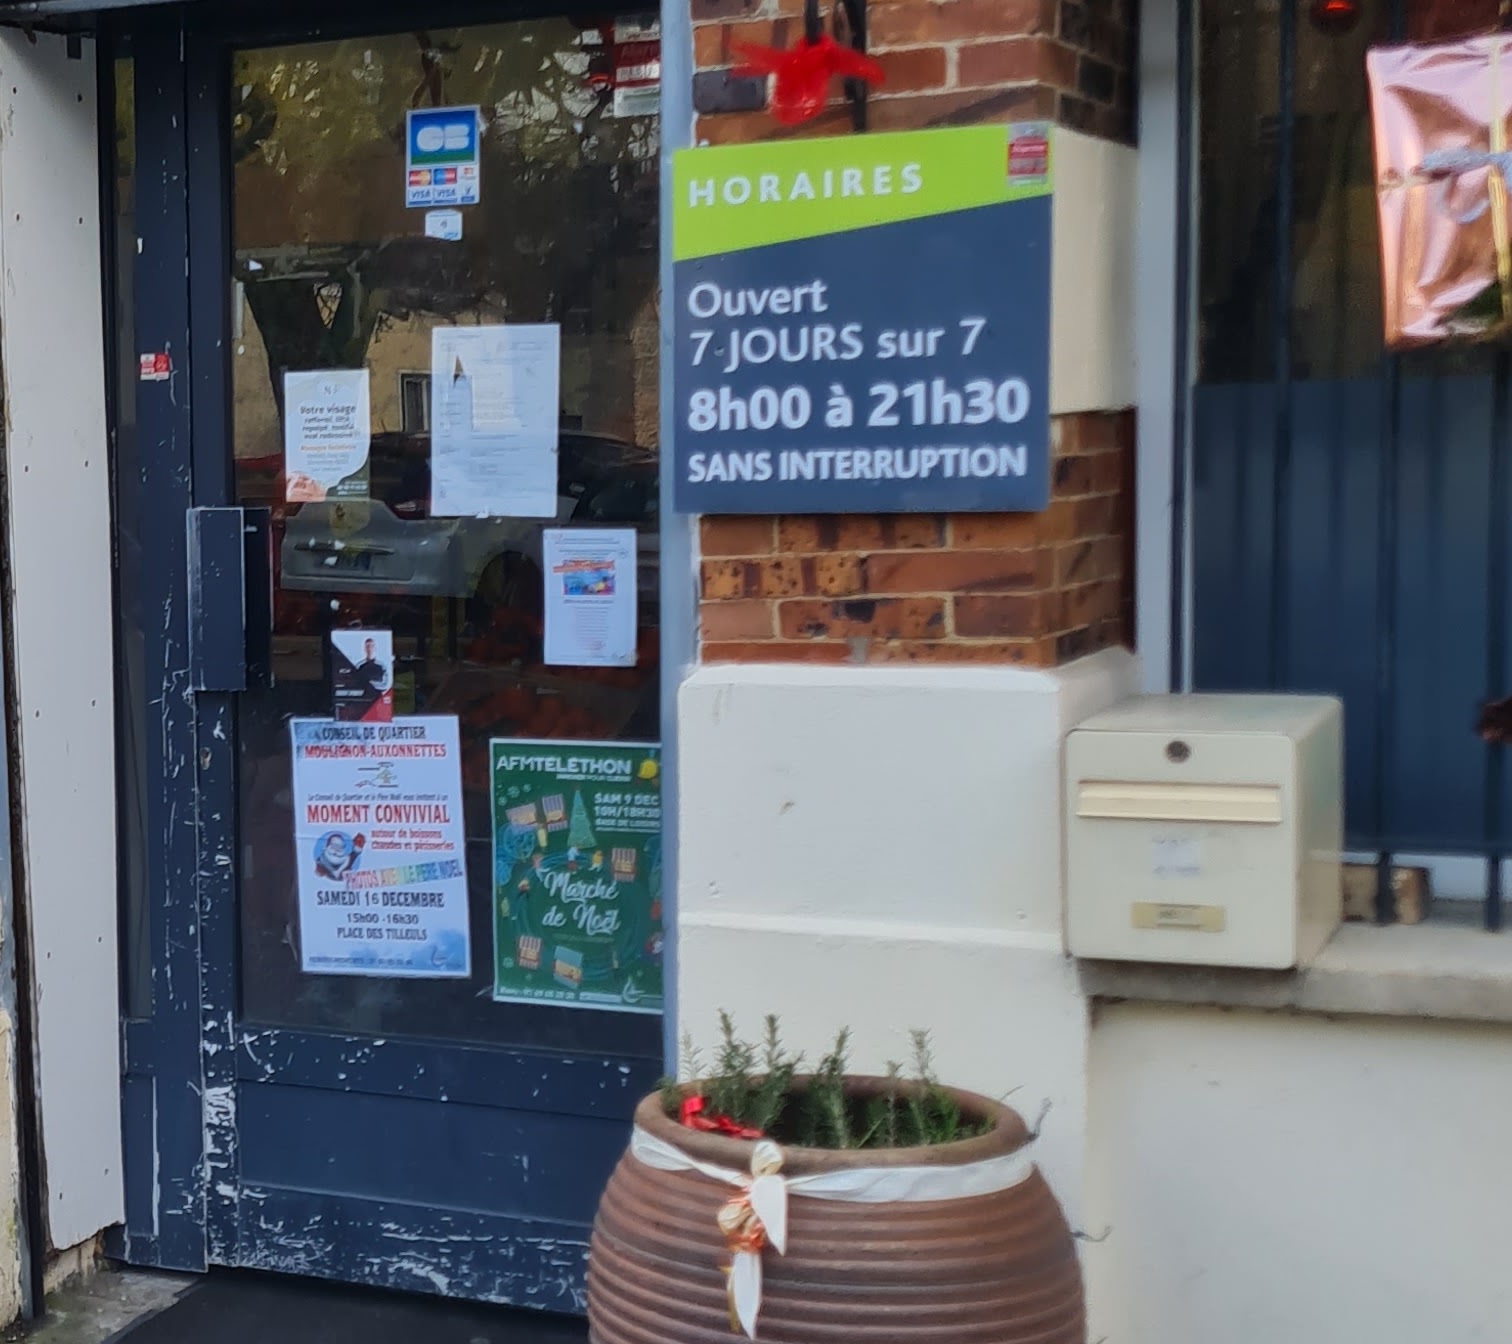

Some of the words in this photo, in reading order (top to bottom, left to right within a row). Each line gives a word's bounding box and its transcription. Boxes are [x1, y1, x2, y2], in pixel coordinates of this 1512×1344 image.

[689, 163, 923, 207] HORAIRES
[688, 279, 829, 318] Ouvert
[689, 332, 712, 367] 7
[723, 322, 864, 373] JOURS
[876, 328, 945, 359] sur
[958, 317, 987, 356] 7
[688, 385, 812, 432] 8h00
[824, 382, 855, 428] à
[866, 376, 1031, 428] 21h30
[688, 450, 773, 483] SANS
[779, 443, 1028, 482] INTERRUPTION
[322, 726, 361, 741] CONSEIL
[363, 726, 375, 740] DE
[378, 726, 426, 742] QUARTIER
[307, 804, 369, 823] MOMENT
[375, 804, 450, 824] CONVIVIAL
[594, 792, 622, 805] SAM
[317, 890, 361, 905] SAMEDI
[364, 891, 380, 905] 16
[382, 891, 445, 908] DECEMBRE
[543, 870, 620, 903] Marché
[347, 913, 379, 923] 15h00
[542, 906, 567, 927] de
[573, 904, 620, 935] Noël
[337, 928, 364, 939] PLACE
[366, 928, 383, 939] DES
[385, 928, 428, 941] TILLEULS
